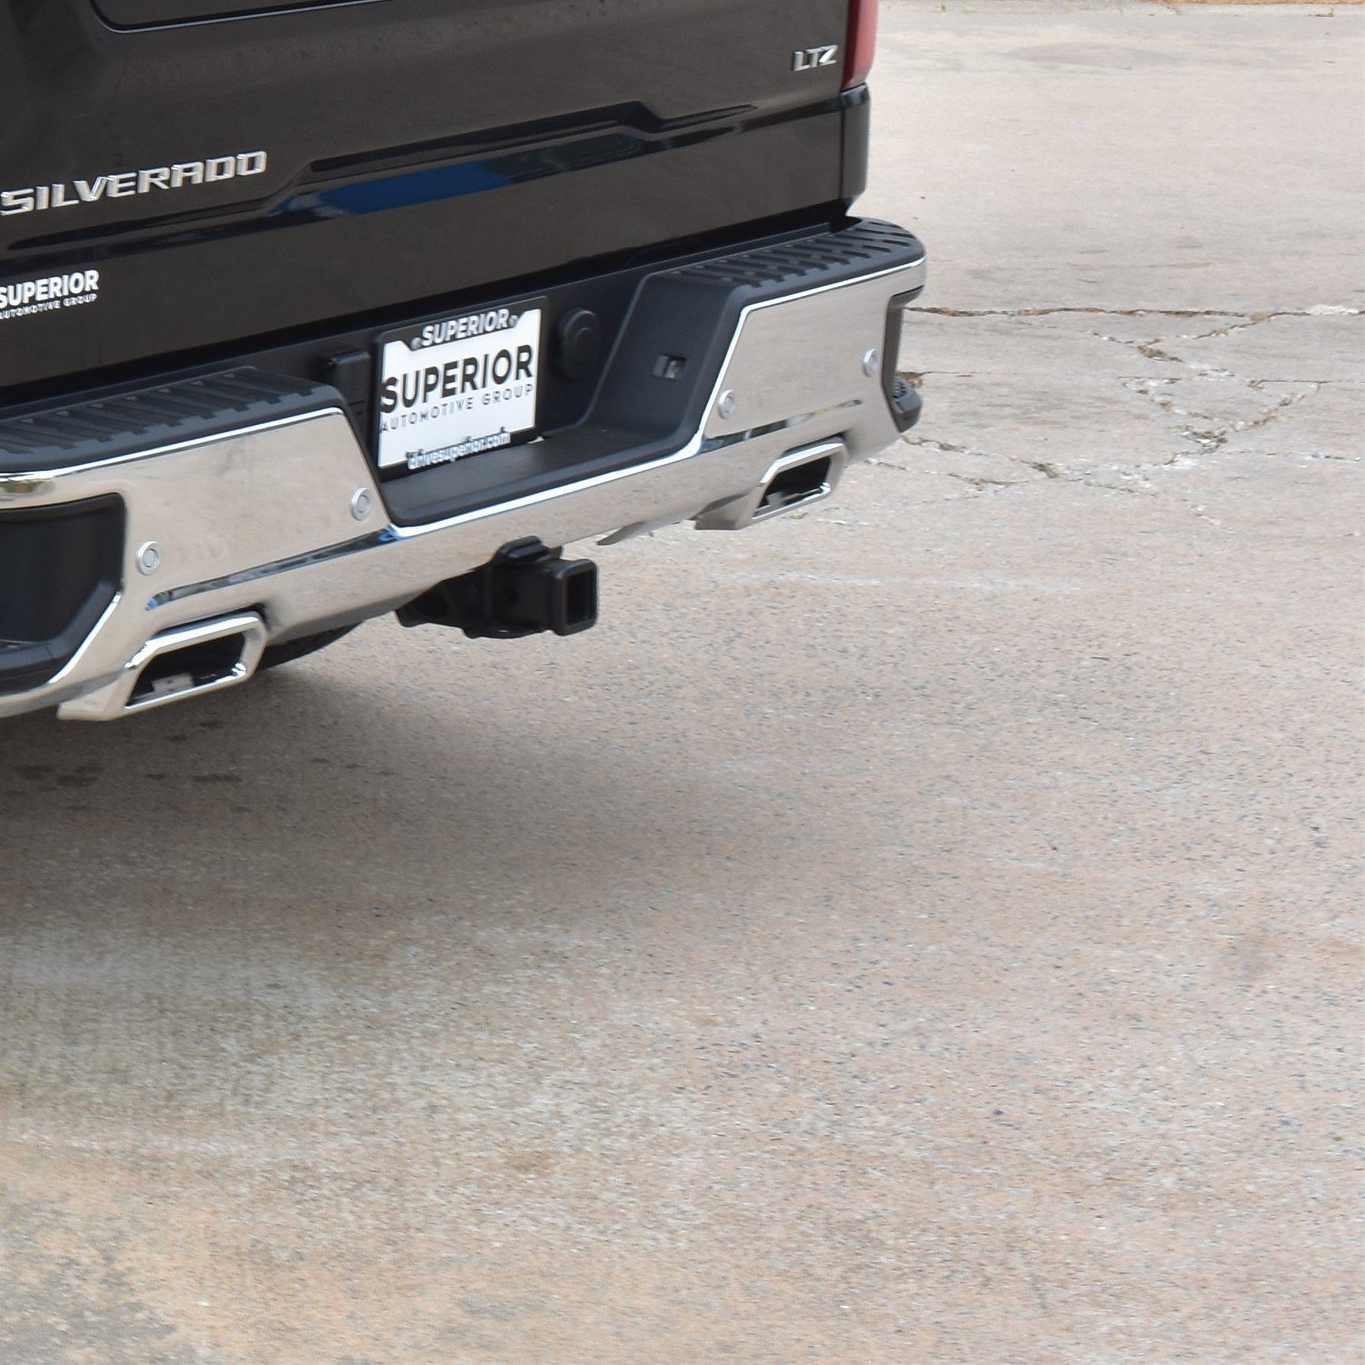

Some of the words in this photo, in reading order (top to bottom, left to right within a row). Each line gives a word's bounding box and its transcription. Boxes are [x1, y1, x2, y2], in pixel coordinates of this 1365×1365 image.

[793, 44, 838, 71] LTZ
[0, 150, 268, 217] SILVERADO
[62, 293, 98, 307] GROUP
[420, 308, 510, 347] SUPERIOR
[379, 344, 534, 414] SUPERIOR
[379, 397, 474, 433] AUTOMOTIVE
[481, 383, 534, 406] GROUP
